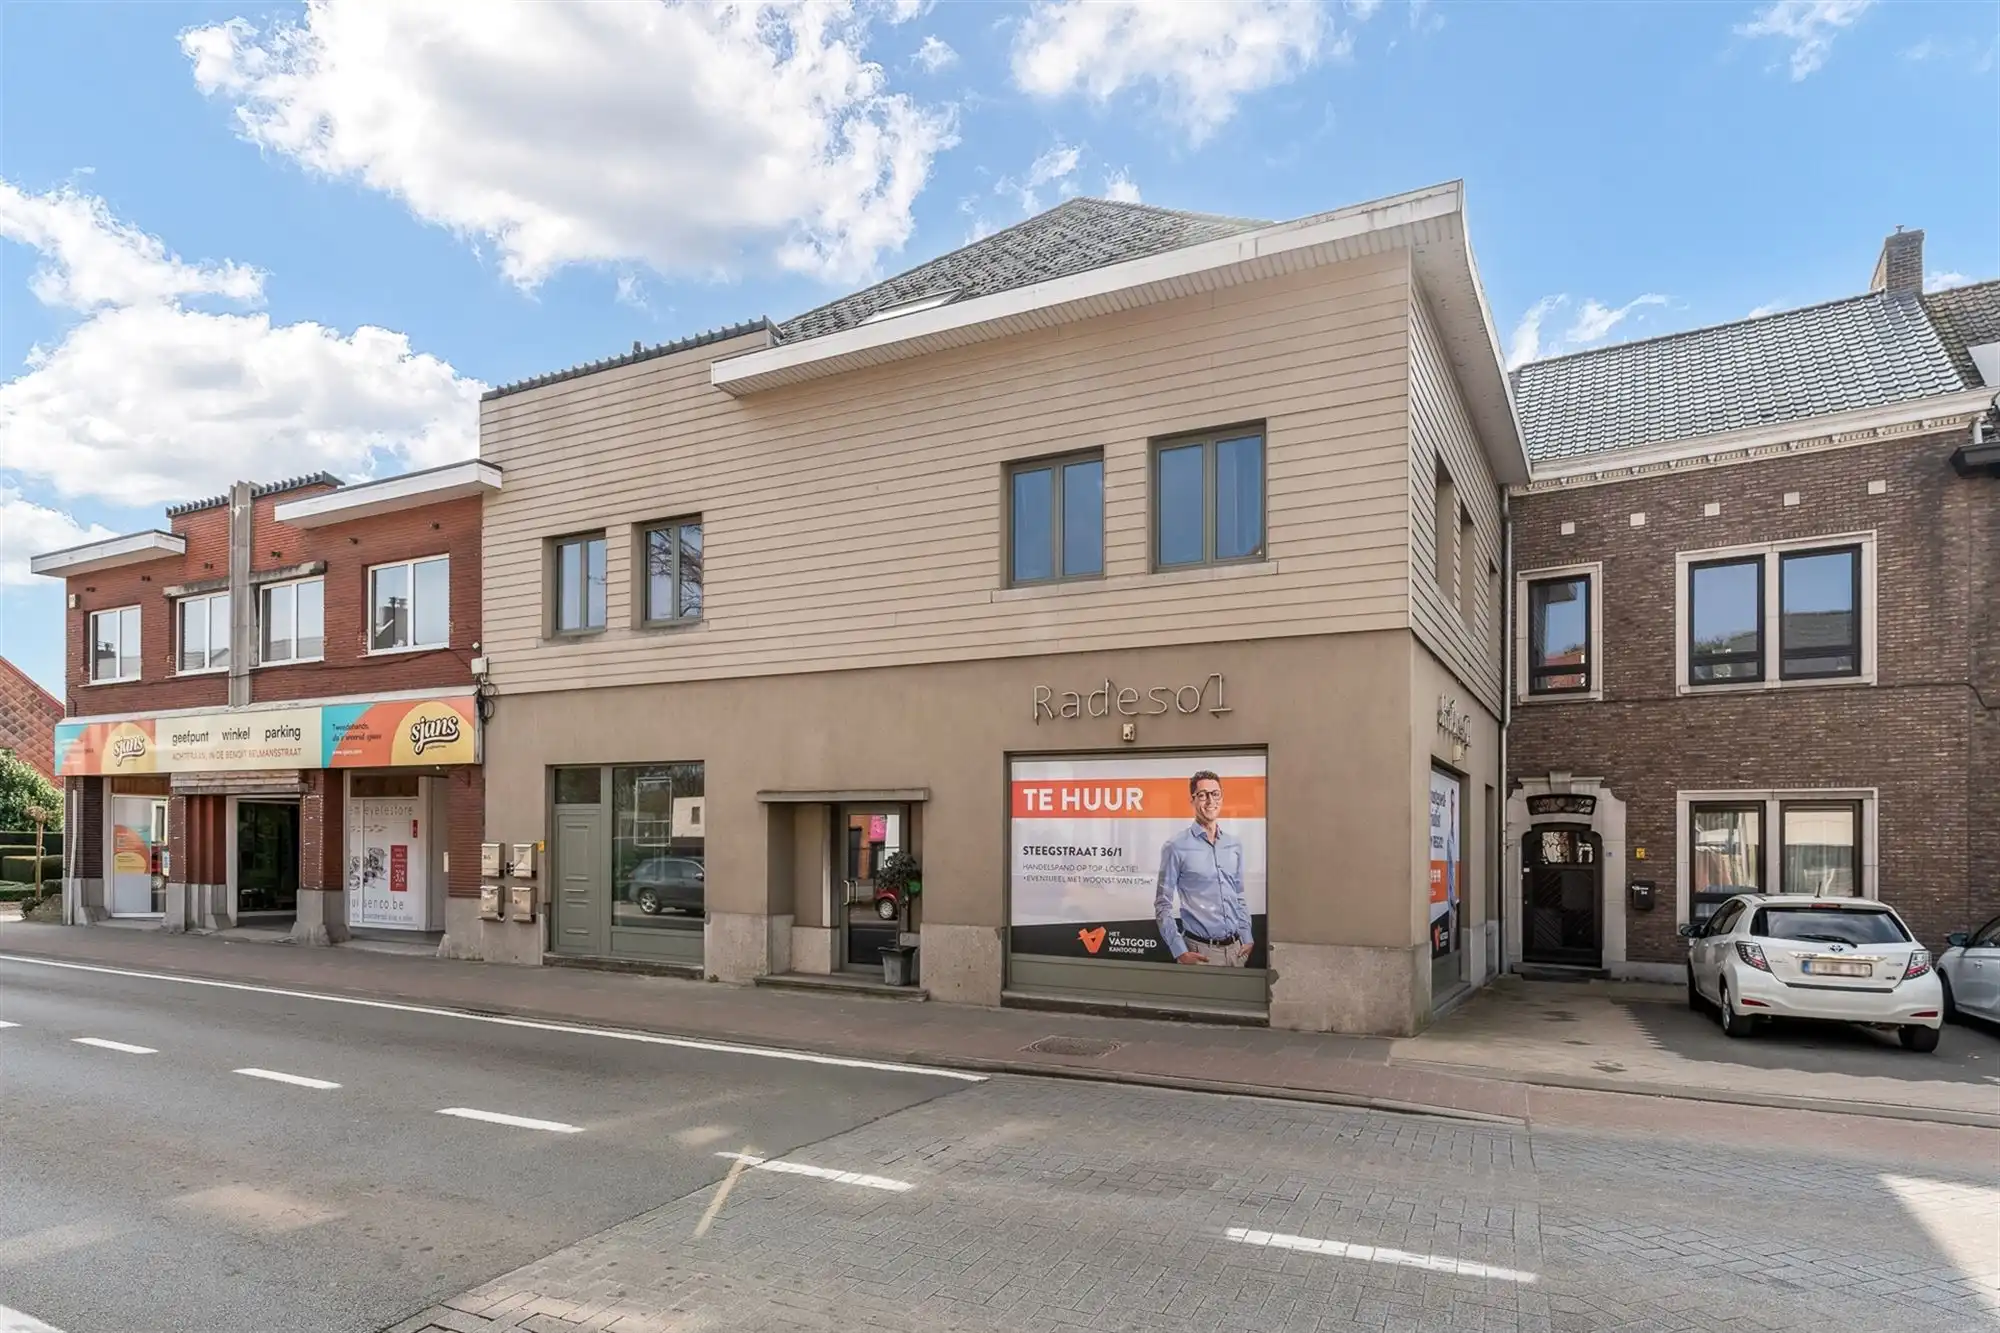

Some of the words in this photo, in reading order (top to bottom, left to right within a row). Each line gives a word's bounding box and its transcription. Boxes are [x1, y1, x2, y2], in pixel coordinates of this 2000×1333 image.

[172, 730, 209, 746] geefpunt
[221, 726, 250, 741] winkel
[265, 724, 301, 742] parking
[410, 716, 460, 755] sjans
[112, 736, 146, 767] sjans
[216, 750, 224, 760] DE
[1023, 788, 1053, 811] TE
[1061, 787, 1144, 811] HUUR
[1023, 845, 1098, 857] STEEGSTRAAT
[1100, 847, 1122, 857] 36/1
[1023, 863, 1075, 872] HANDELSPAND
[1076, 864, 1087, 872] OP
[1082, 876, 1114, 884] WOONST
[1115, 877, 1133, 885] VAN
[1109, 937, 1157, 948] VASTGOED
